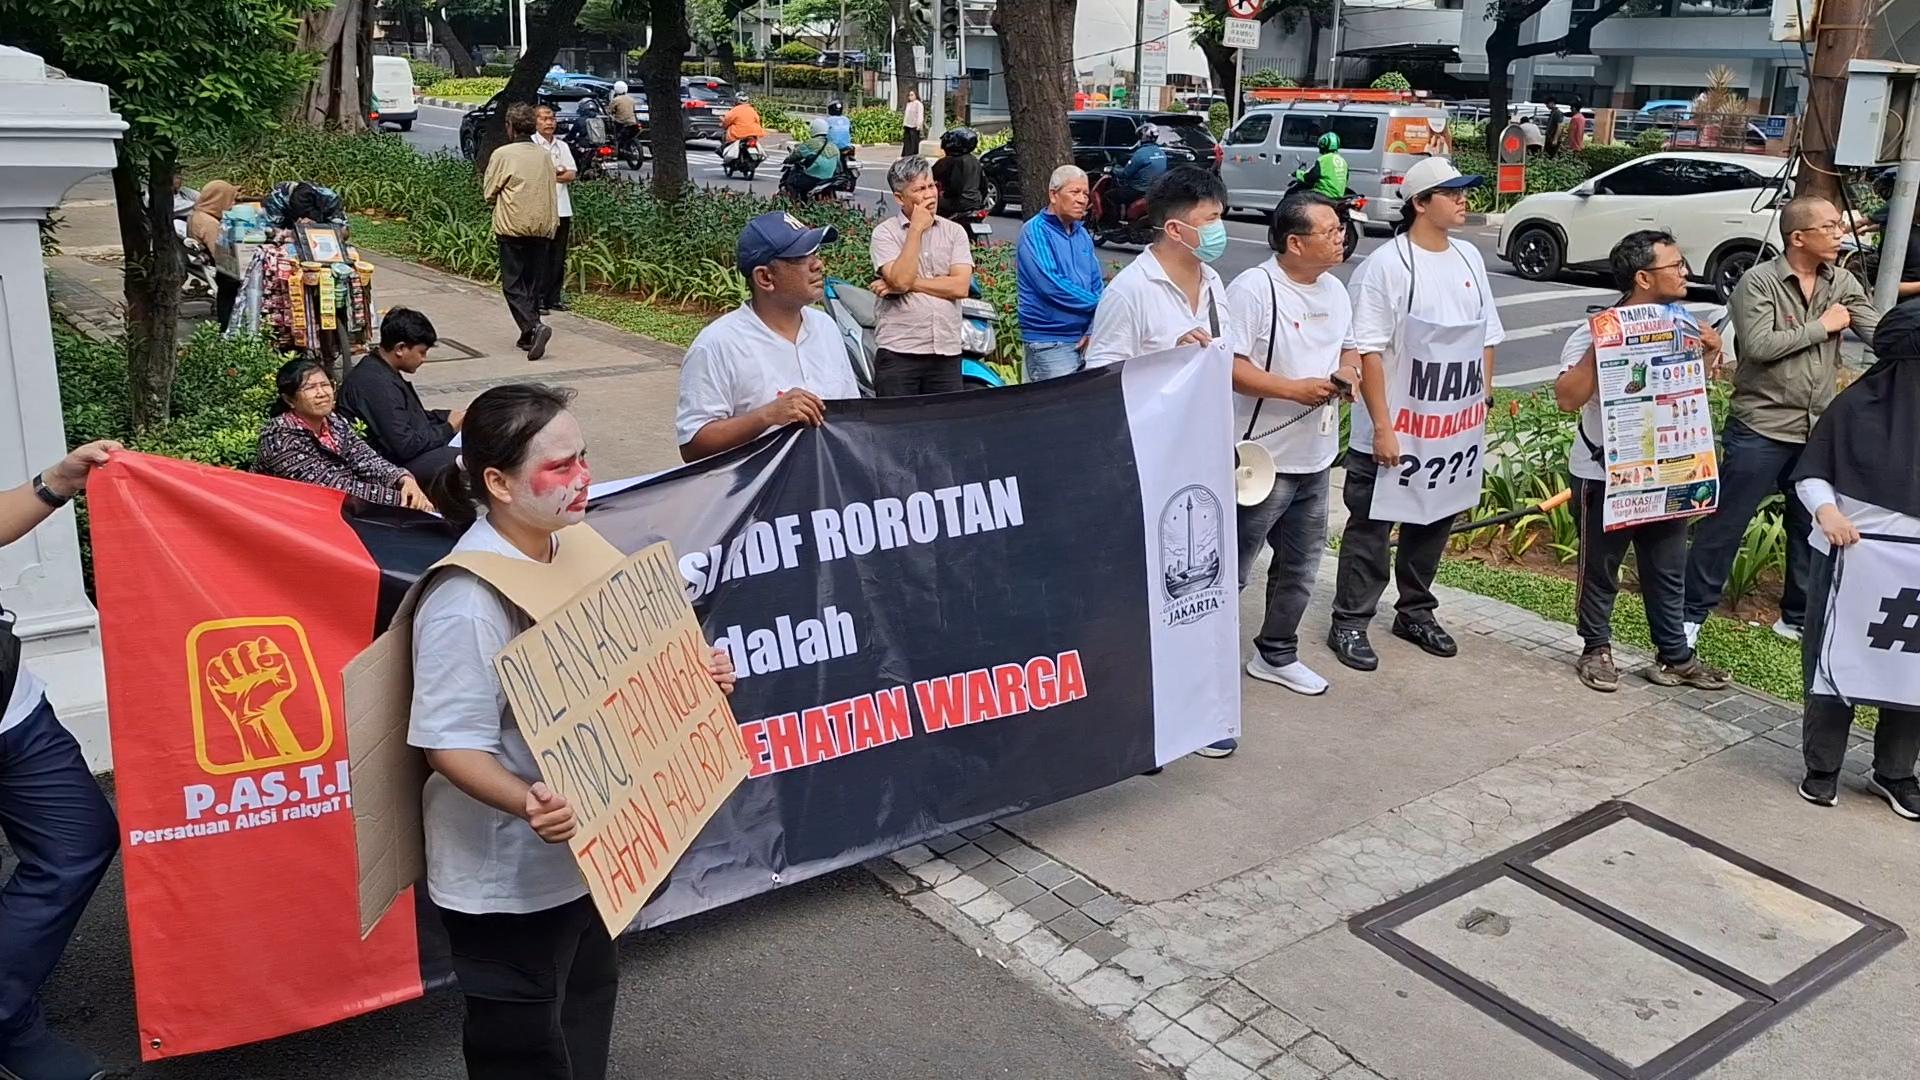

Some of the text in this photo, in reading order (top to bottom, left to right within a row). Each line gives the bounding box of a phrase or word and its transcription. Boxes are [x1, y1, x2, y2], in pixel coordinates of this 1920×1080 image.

[1227, 36, 1256, 45] BERIKUT
[1230, 29, 1255, 38] RAMBU
[1231, 21, 1256, 30] SAMPAI
[1398, 444, 1479, 490] ????
[811, 476, 1024, 562] ROROTAN
[1167, 597, 1219, 626] JAKARTA
[714, 605, 858, 679] dalah
[738, 649, 1087, 779] EHATAN WARGA
[129, 819, 230, 846] Persatuan
[578, 784, 670, 914] TAHAN
[653, 742, 706, 841] BAU
